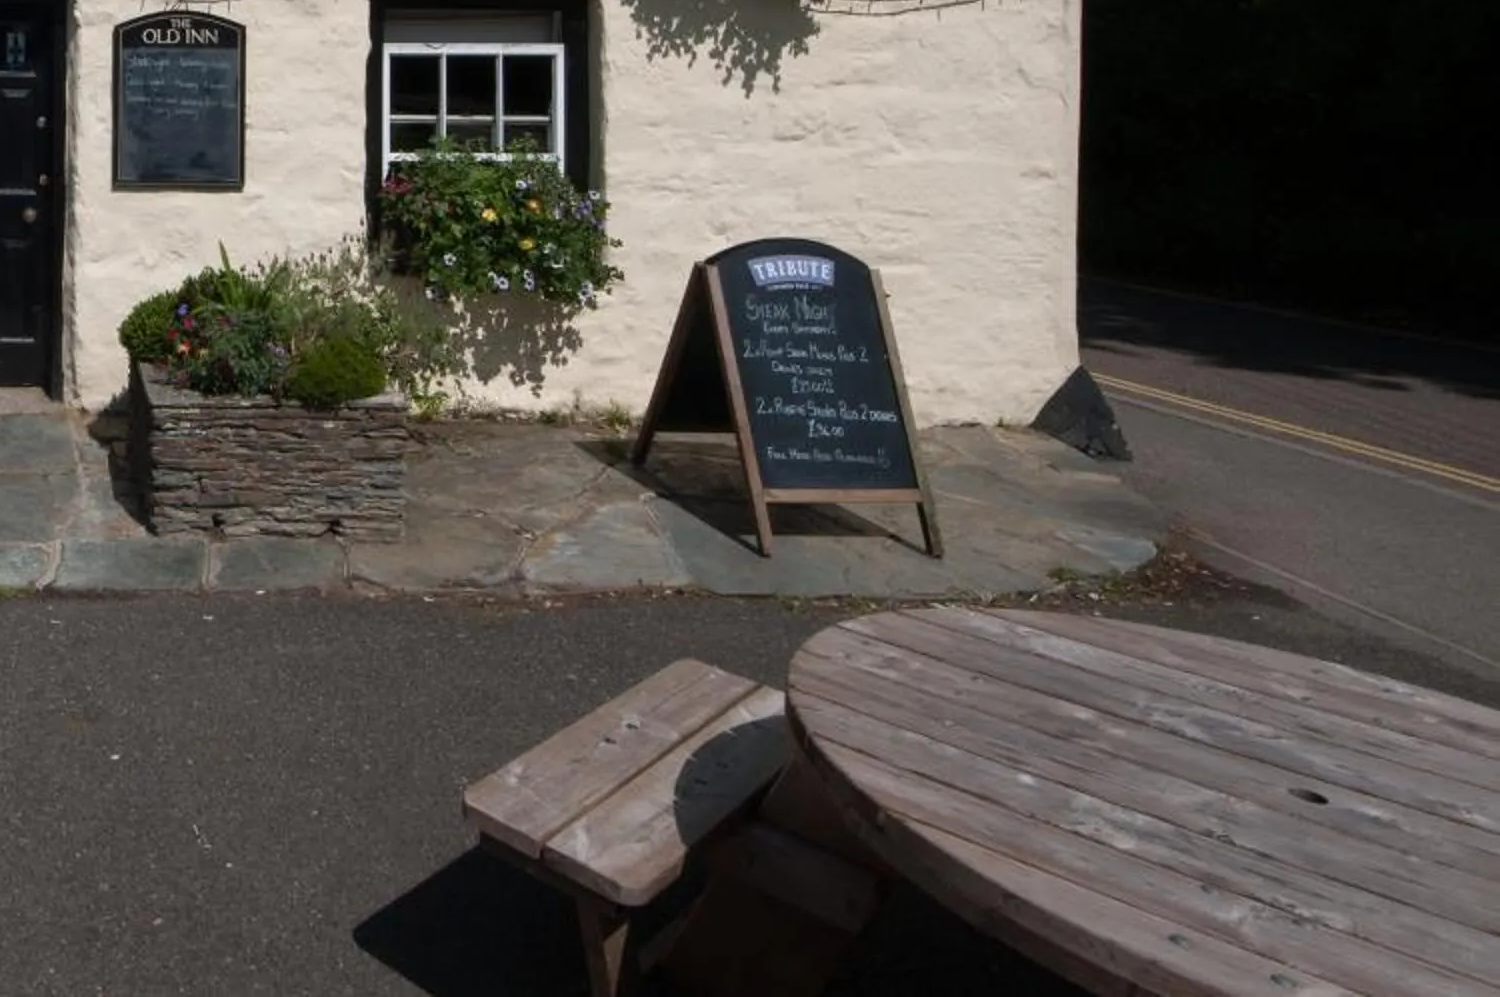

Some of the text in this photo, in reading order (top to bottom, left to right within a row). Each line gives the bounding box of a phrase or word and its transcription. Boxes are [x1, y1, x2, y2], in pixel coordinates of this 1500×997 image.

[170, 18, 192, 28] THE
[143, 28, 220, 44] OLD INN
[753, 260, 832, 281] TRIBUTE
